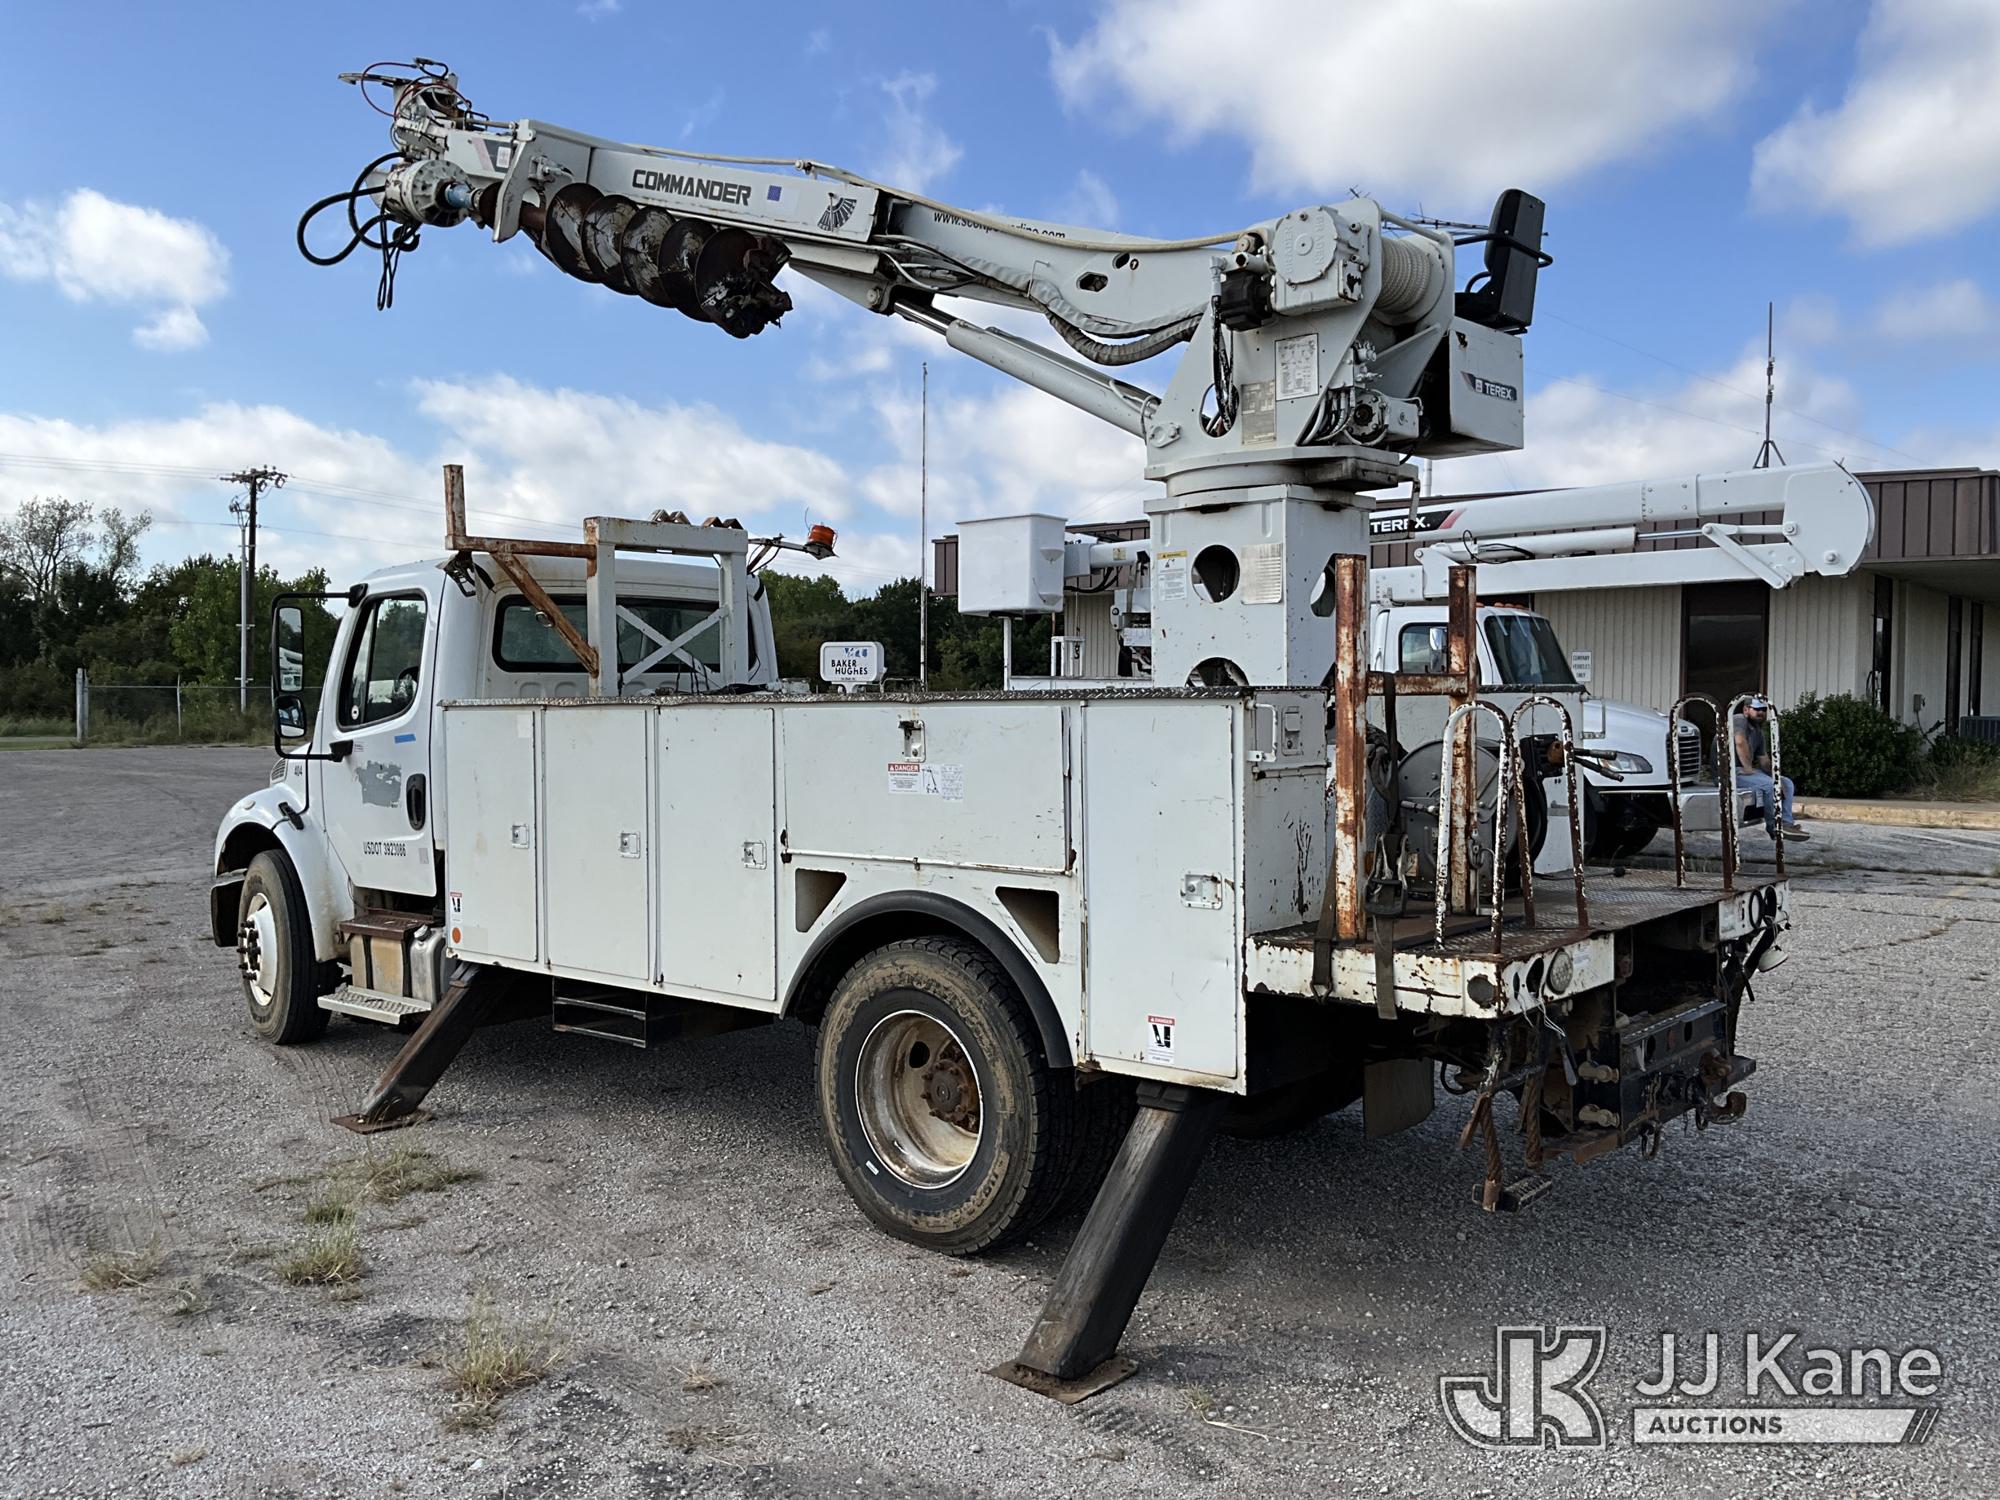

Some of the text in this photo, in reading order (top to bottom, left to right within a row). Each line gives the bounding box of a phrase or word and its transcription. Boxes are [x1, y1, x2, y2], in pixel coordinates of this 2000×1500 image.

[632, 169, 752, 206] COMMANDER
[831, 659, 857, 668] BAKER
[895, 764, 919, 772] DANGER
[363, 841, 382, 855] USDOT
